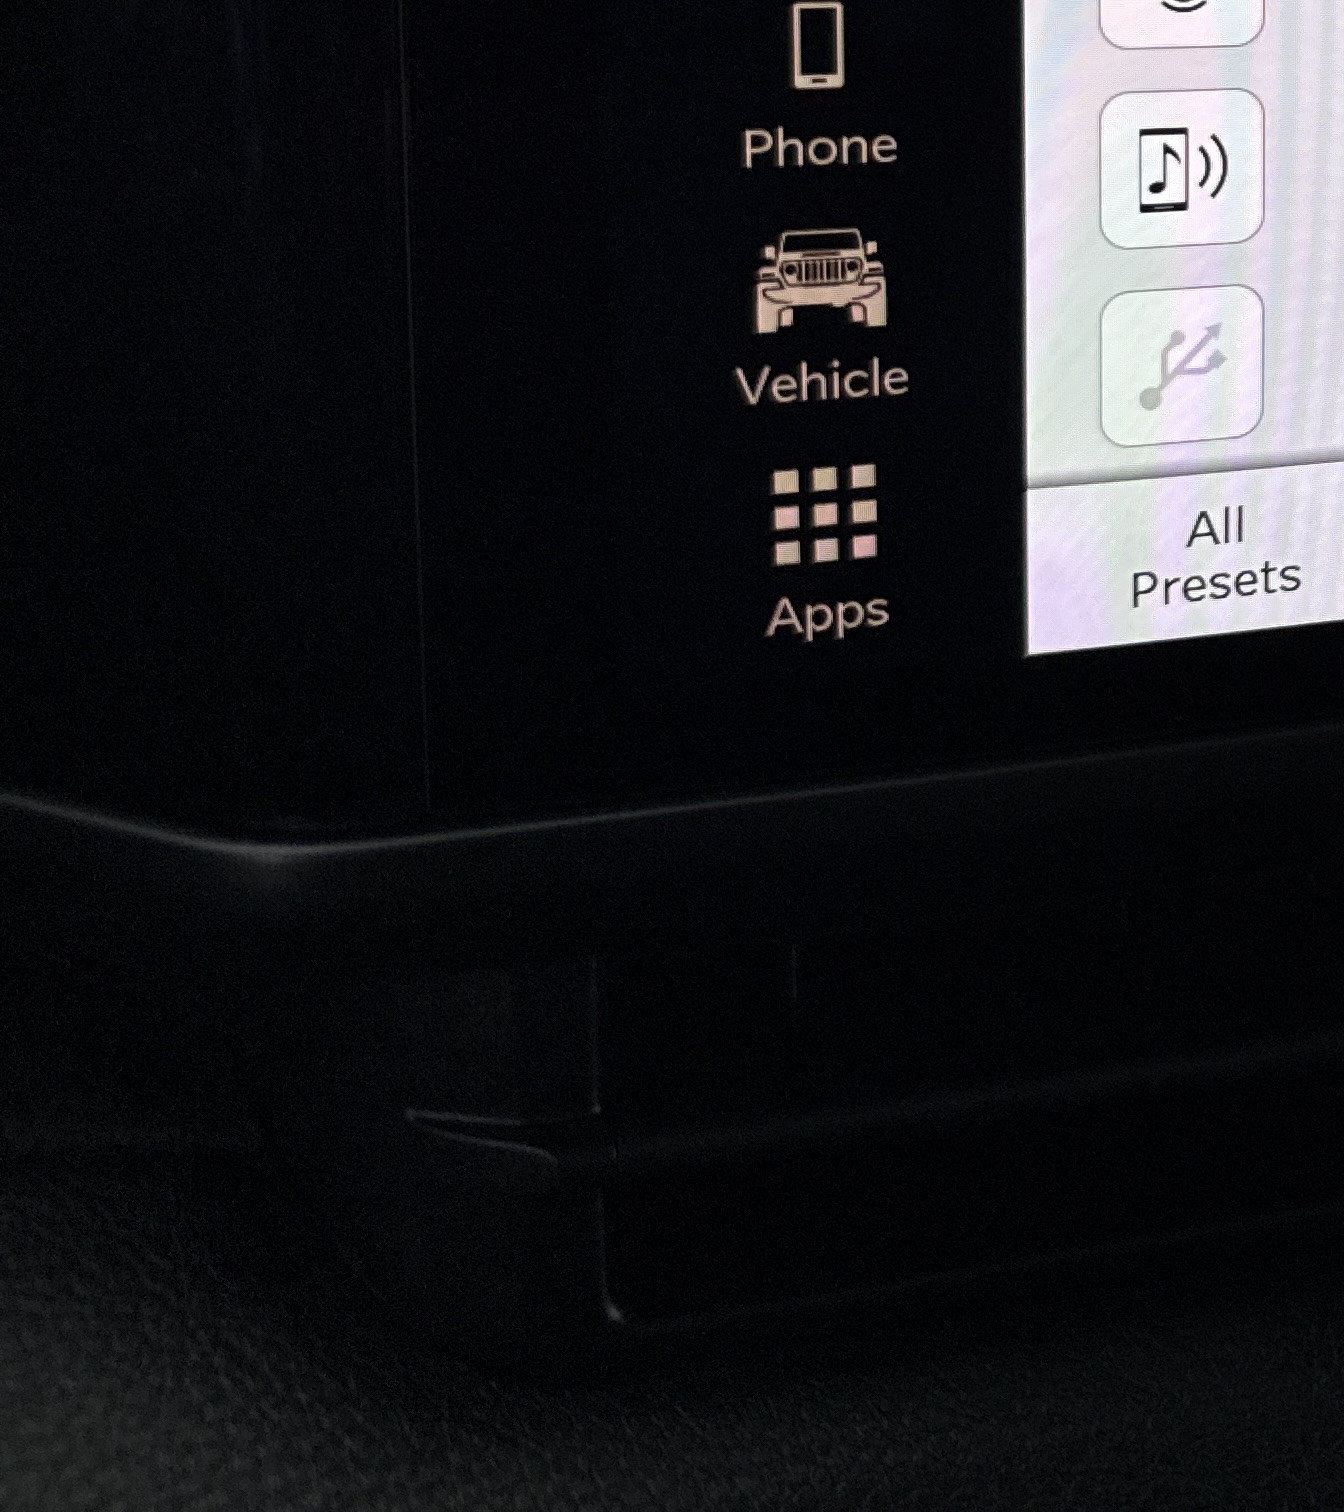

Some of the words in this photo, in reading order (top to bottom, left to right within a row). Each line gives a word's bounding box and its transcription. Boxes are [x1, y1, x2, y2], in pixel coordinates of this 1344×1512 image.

[746, 128, 897, 168] Phone
[737, 359, 909, 405] Vehicle
[1188, 507, 1244, 548] All
[1134, 562, 1302, 608] Presets
[768, 599, 890, 642] Apps
